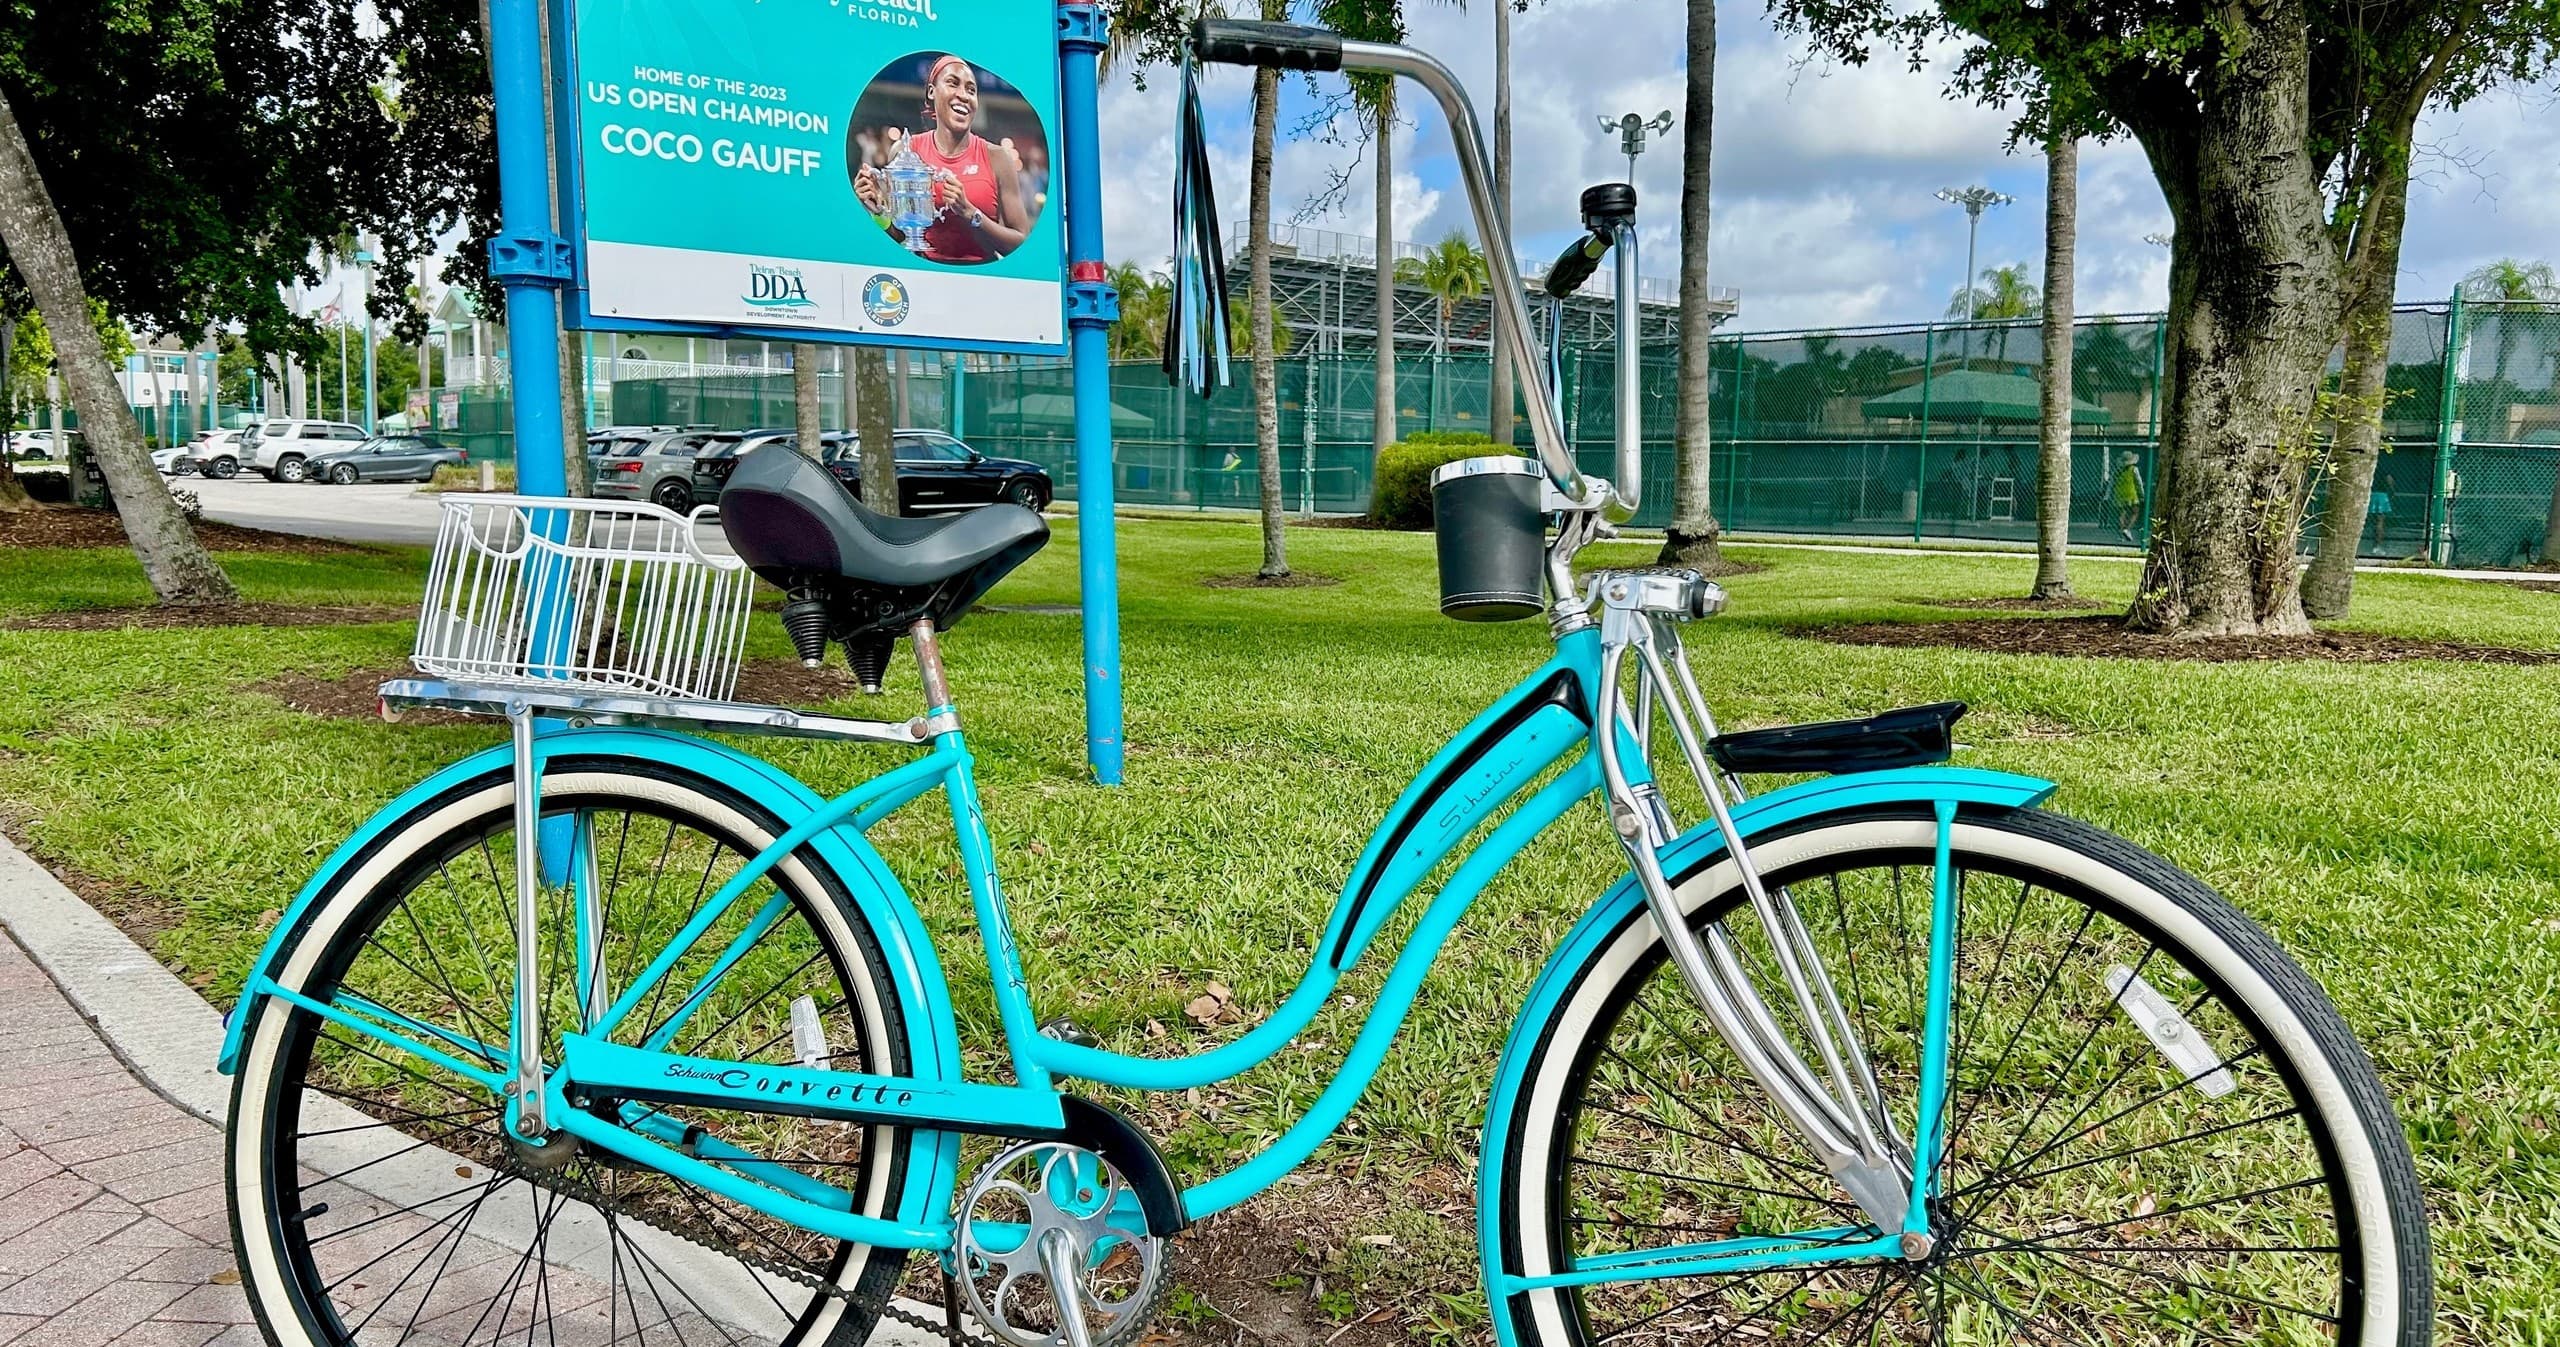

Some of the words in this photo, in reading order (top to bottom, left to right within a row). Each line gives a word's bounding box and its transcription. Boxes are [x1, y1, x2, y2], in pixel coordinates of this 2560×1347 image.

[848, 4, 919, 28] FLORIDA
[634, 65, 683, 87] HOME
[687, 74, 711, 90] OF
[714, 77, 745, 96] THE
[749, 83, 787, 102] 2023
[587, 81, 621, 105] US
[628, 88, 697, 117] OPEN
[703, 98, 829, 135] CHAMPION
[601, 123, 703, 163] COCO
[711, 138, 822, 177] GAUFF
[776, 265, 804, 279] Beach
[865, 277, 878, 292] CITY
[892, 279, 903, 289] OF
[751, 273, 807, 301] DDA
[746, 311, 785, 319] DEVELOPMENT
[765, 306, 799, 314] DOWNTOWN
[864, 302, 884, 325] DELRAY
[893, 301, 909, 325] BEACH
[1439, 758, 1524, 843] Schwinn
[664, 1063, 722, 1082] Schwinn
[719, 1069, 912, 1107] Corvette
